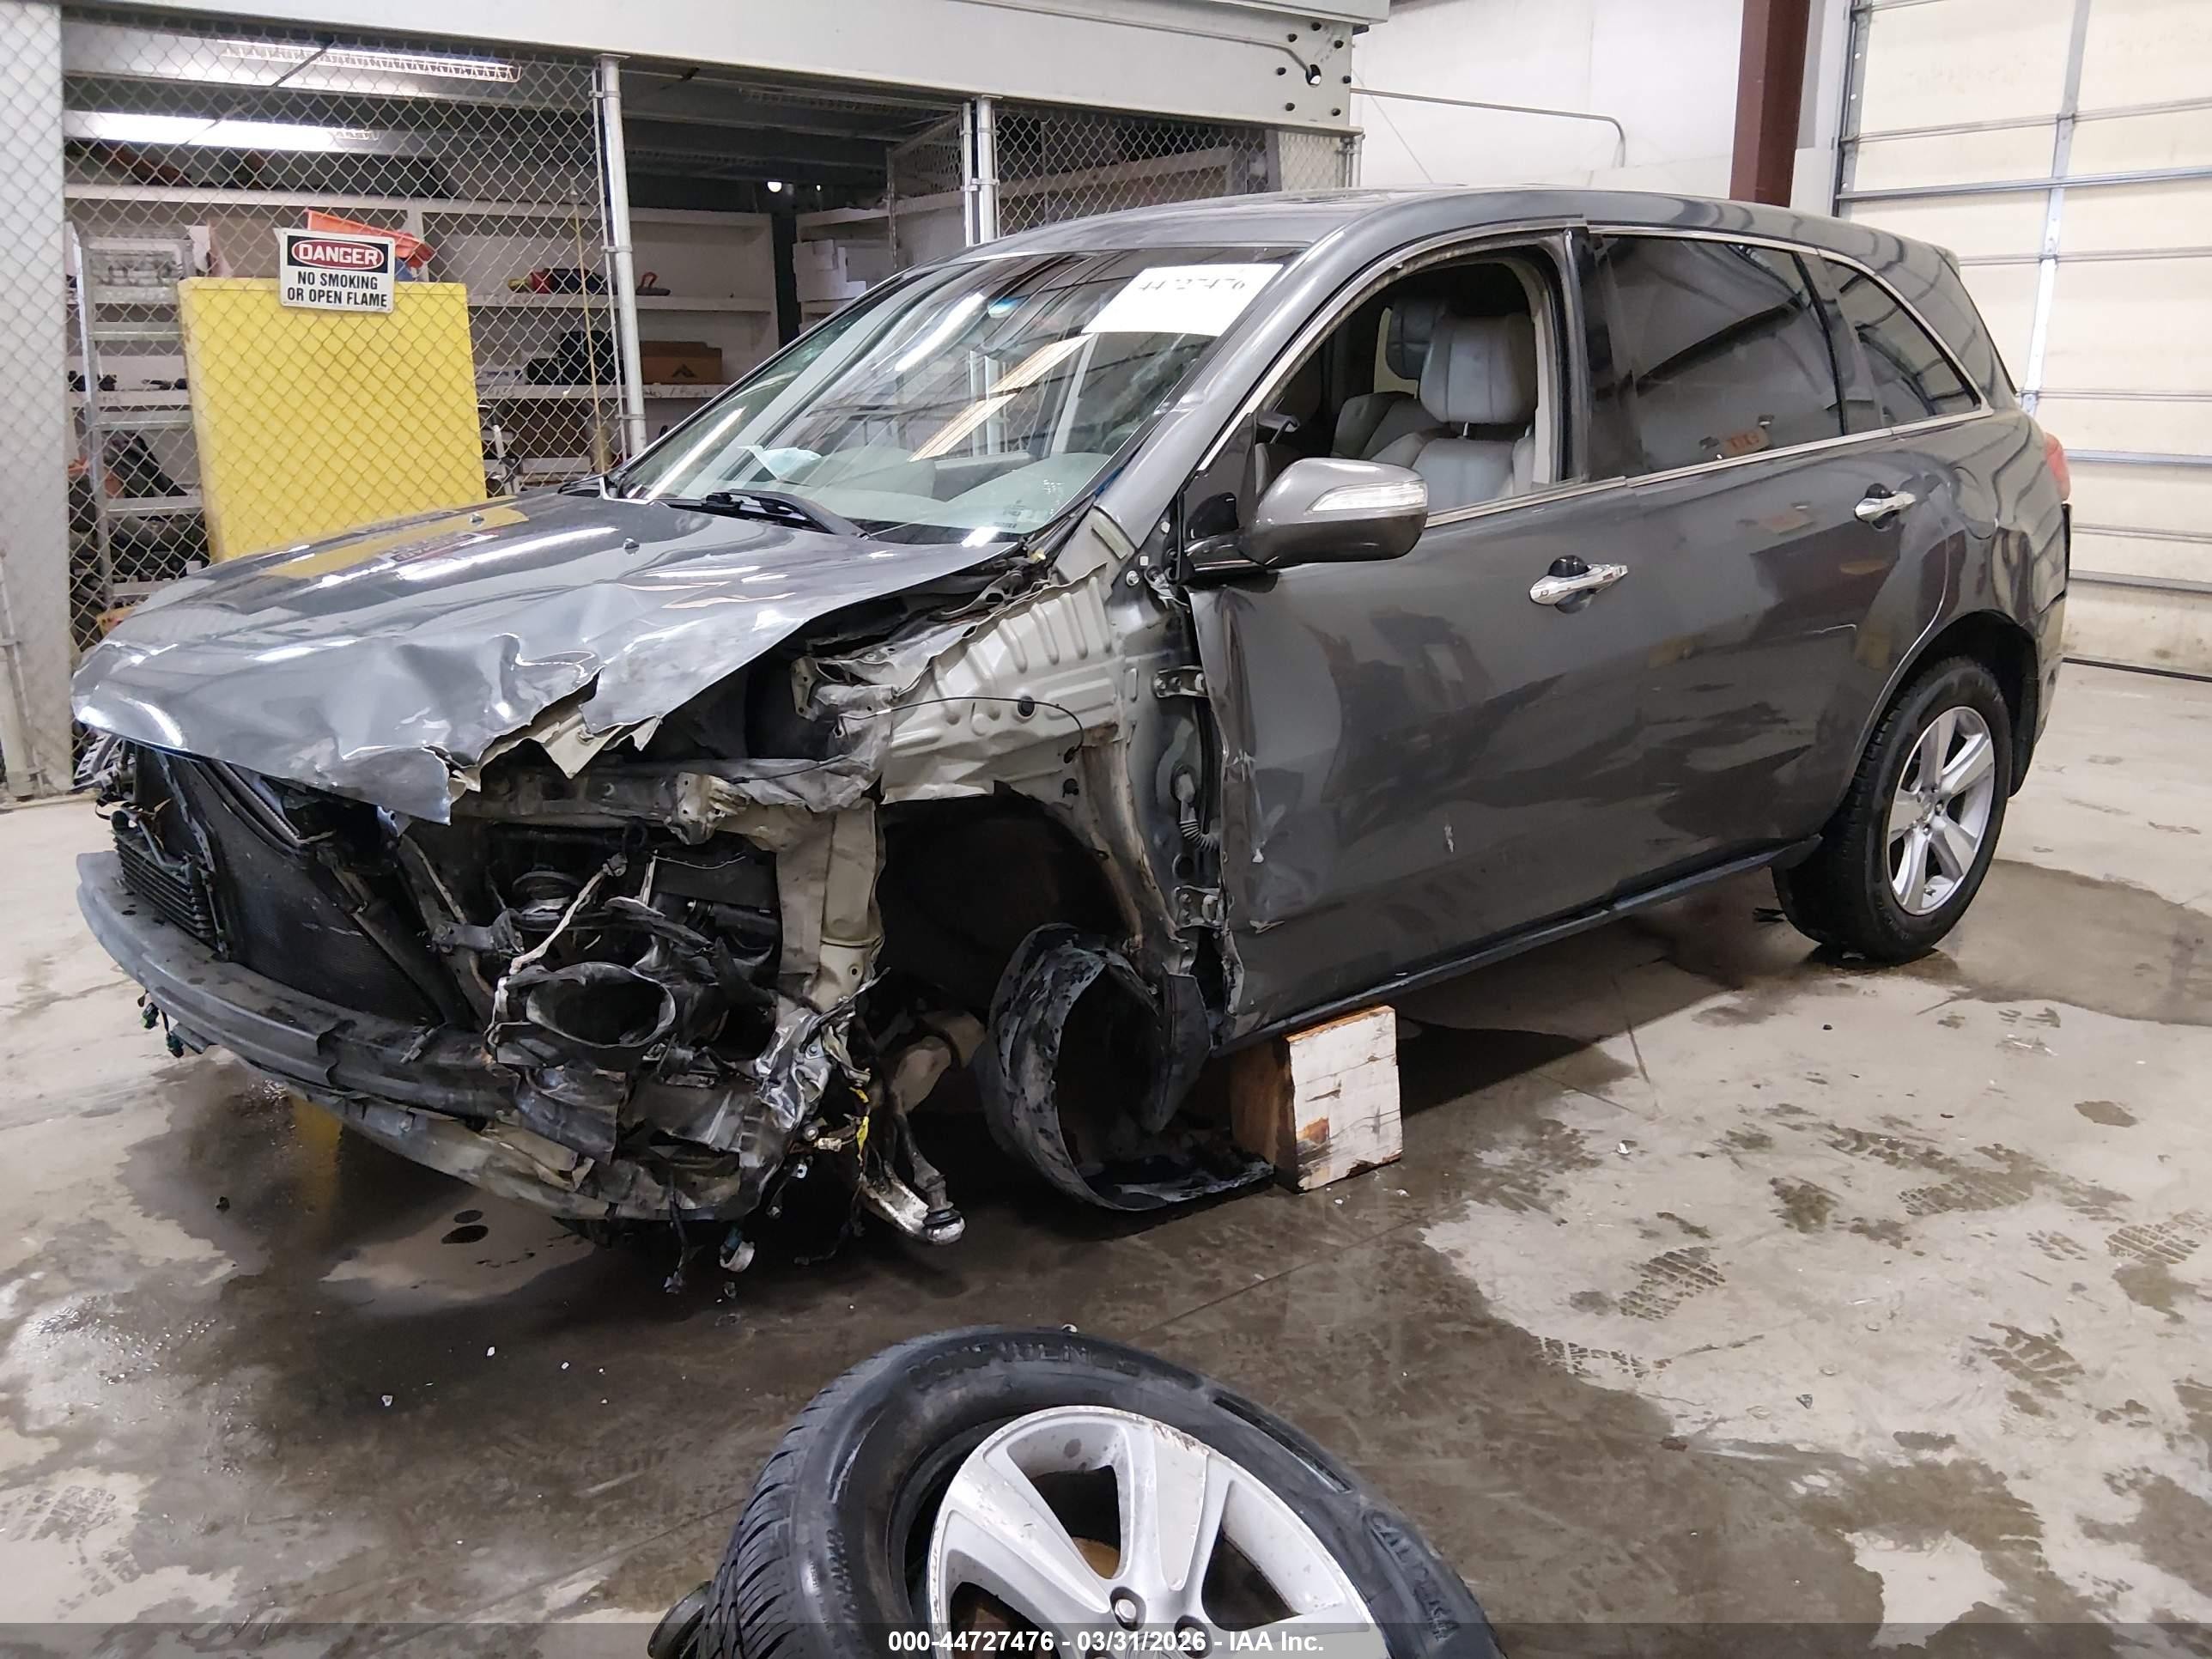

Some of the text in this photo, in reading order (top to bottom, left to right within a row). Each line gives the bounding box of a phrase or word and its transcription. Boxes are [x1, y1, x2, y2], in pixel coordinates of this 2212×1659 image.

[298, 244, 378, 265] DANGER
[298, 271, 378, 289] NO SMOKING
[287, 288, 387, 307] OR OPEN FLAME
